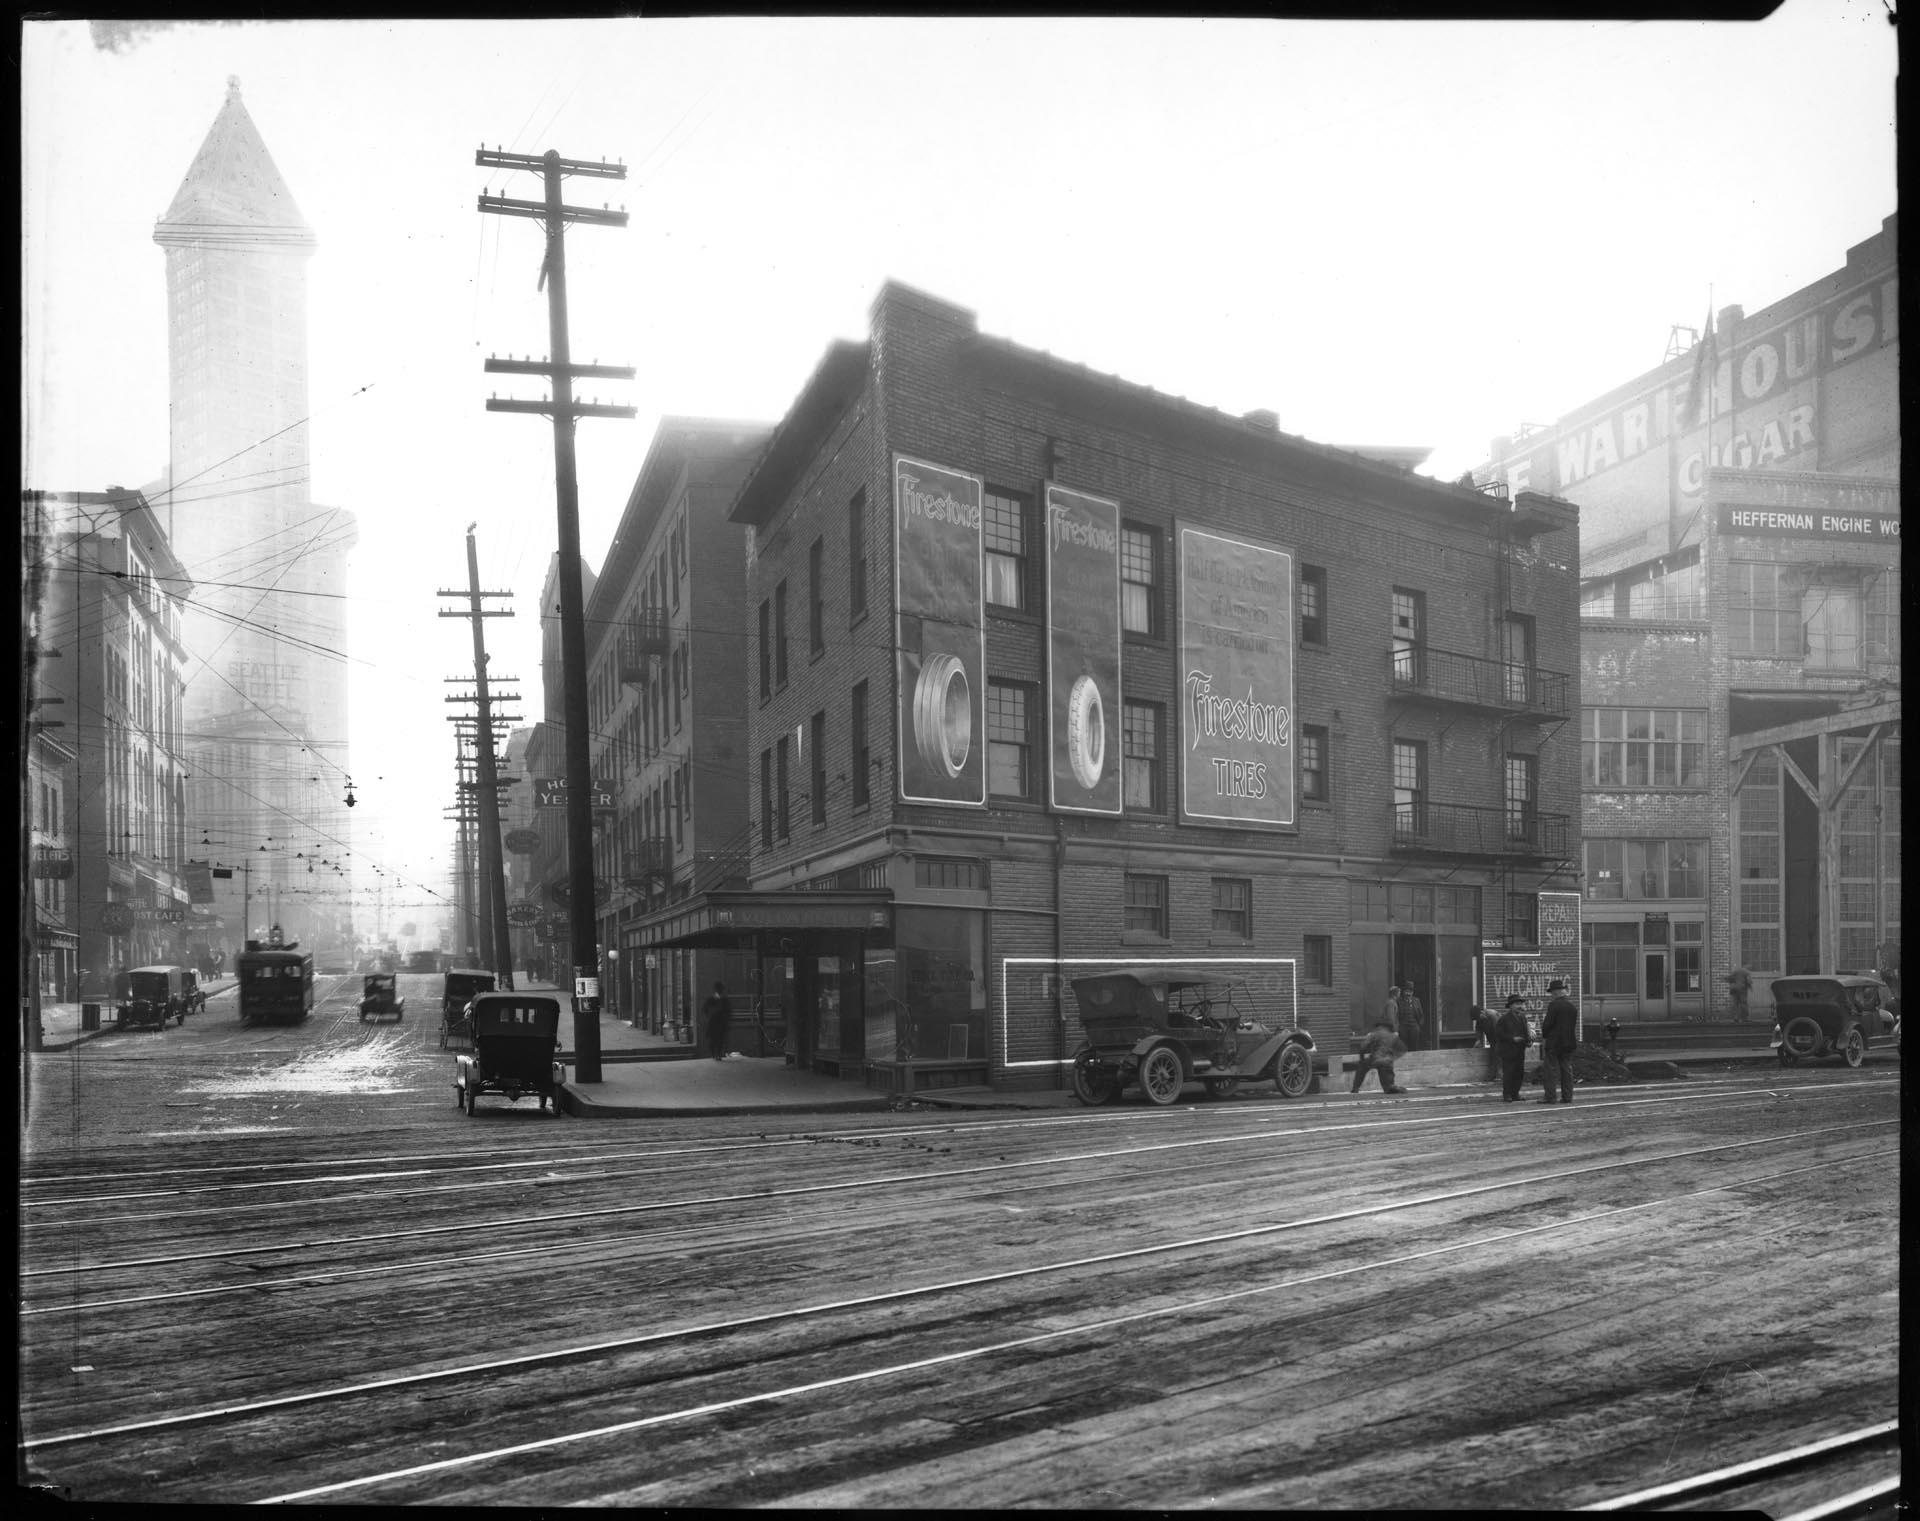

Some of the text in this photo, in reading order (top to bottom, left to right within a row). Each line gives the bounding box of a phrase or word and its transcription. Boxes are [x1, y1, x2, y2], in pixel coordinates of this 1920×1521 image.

[899, 474, 981, 530] Firestone
[1050, 504, 1116, 554] Firestone
[1732, 511, 1813, 530] HEFFERNAN
[1822, 516, 1872, 533] ENGINE
[1187, 670, 1290, 751] Firestone
[547, 778, 603, 791] HOL
[1212, 757, 1267, 800] TIRES
[540, 792, 611, 806] YEER
[154, 911, 183, 921] CAFE
[1541, 904, 1576, 922] REPAIR
[1546, 928, 1575, 946] SHOP
[1493, 974, 1572, 998] VULCANIZG
